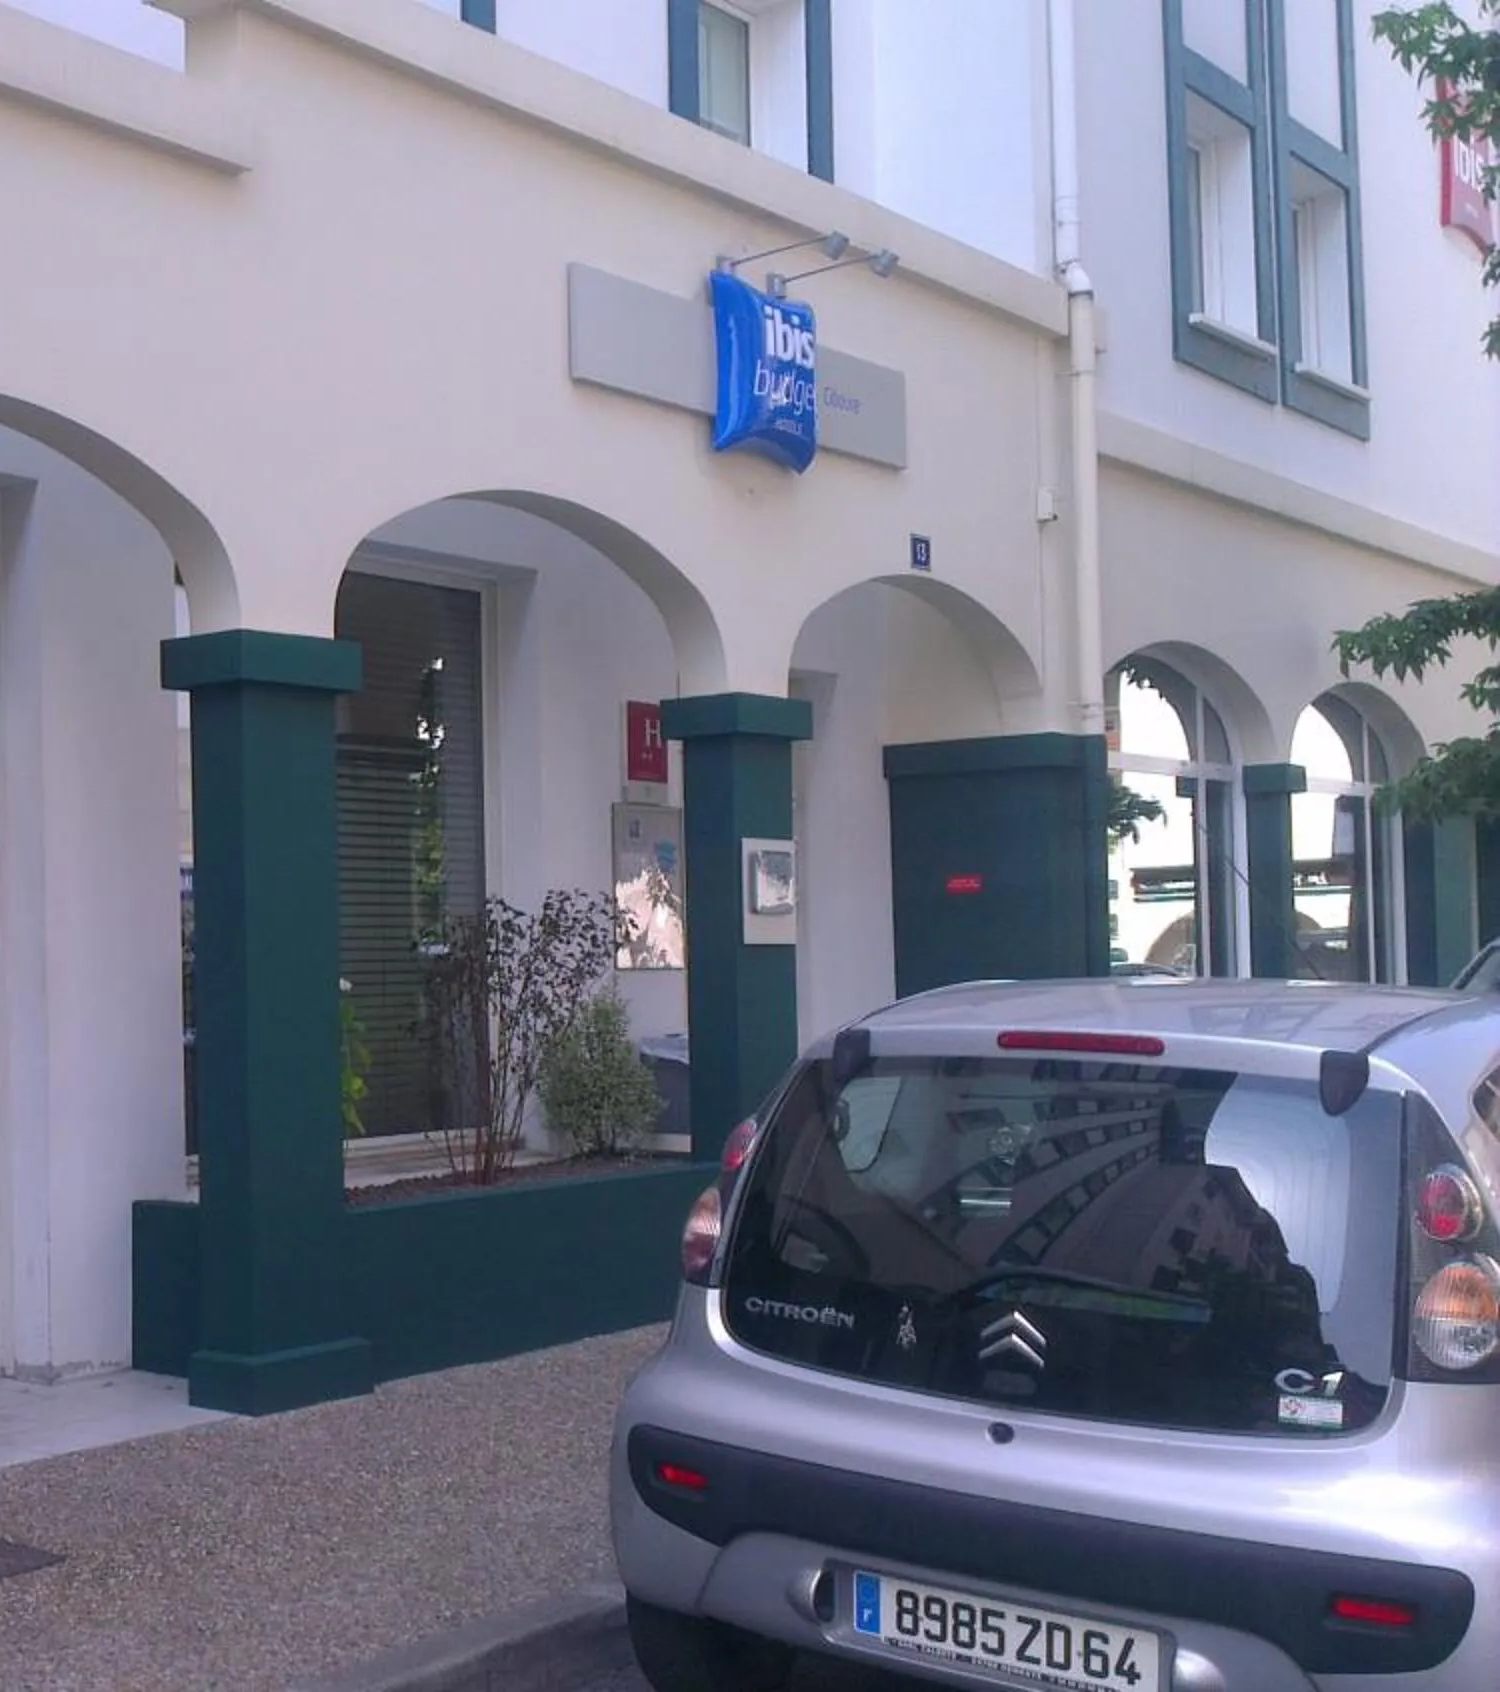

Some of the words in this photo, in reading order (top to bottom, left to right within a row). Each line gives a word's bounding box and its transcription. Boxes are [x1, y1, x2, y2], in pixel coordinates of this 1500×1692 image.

[763, 304, 815, 369] ibis
[754, 359, 817, 416] budge
[644, 718, 662, 749] H
[744, 1296, 856, 1329] CITROËN
[1274, 1367, 1344, 1396] C1
[895, 1588, 1007, 1657] 8985
[1015, 1614, 1073, 1671] ZD
[1082, 1629, 1142, 1686] 64
